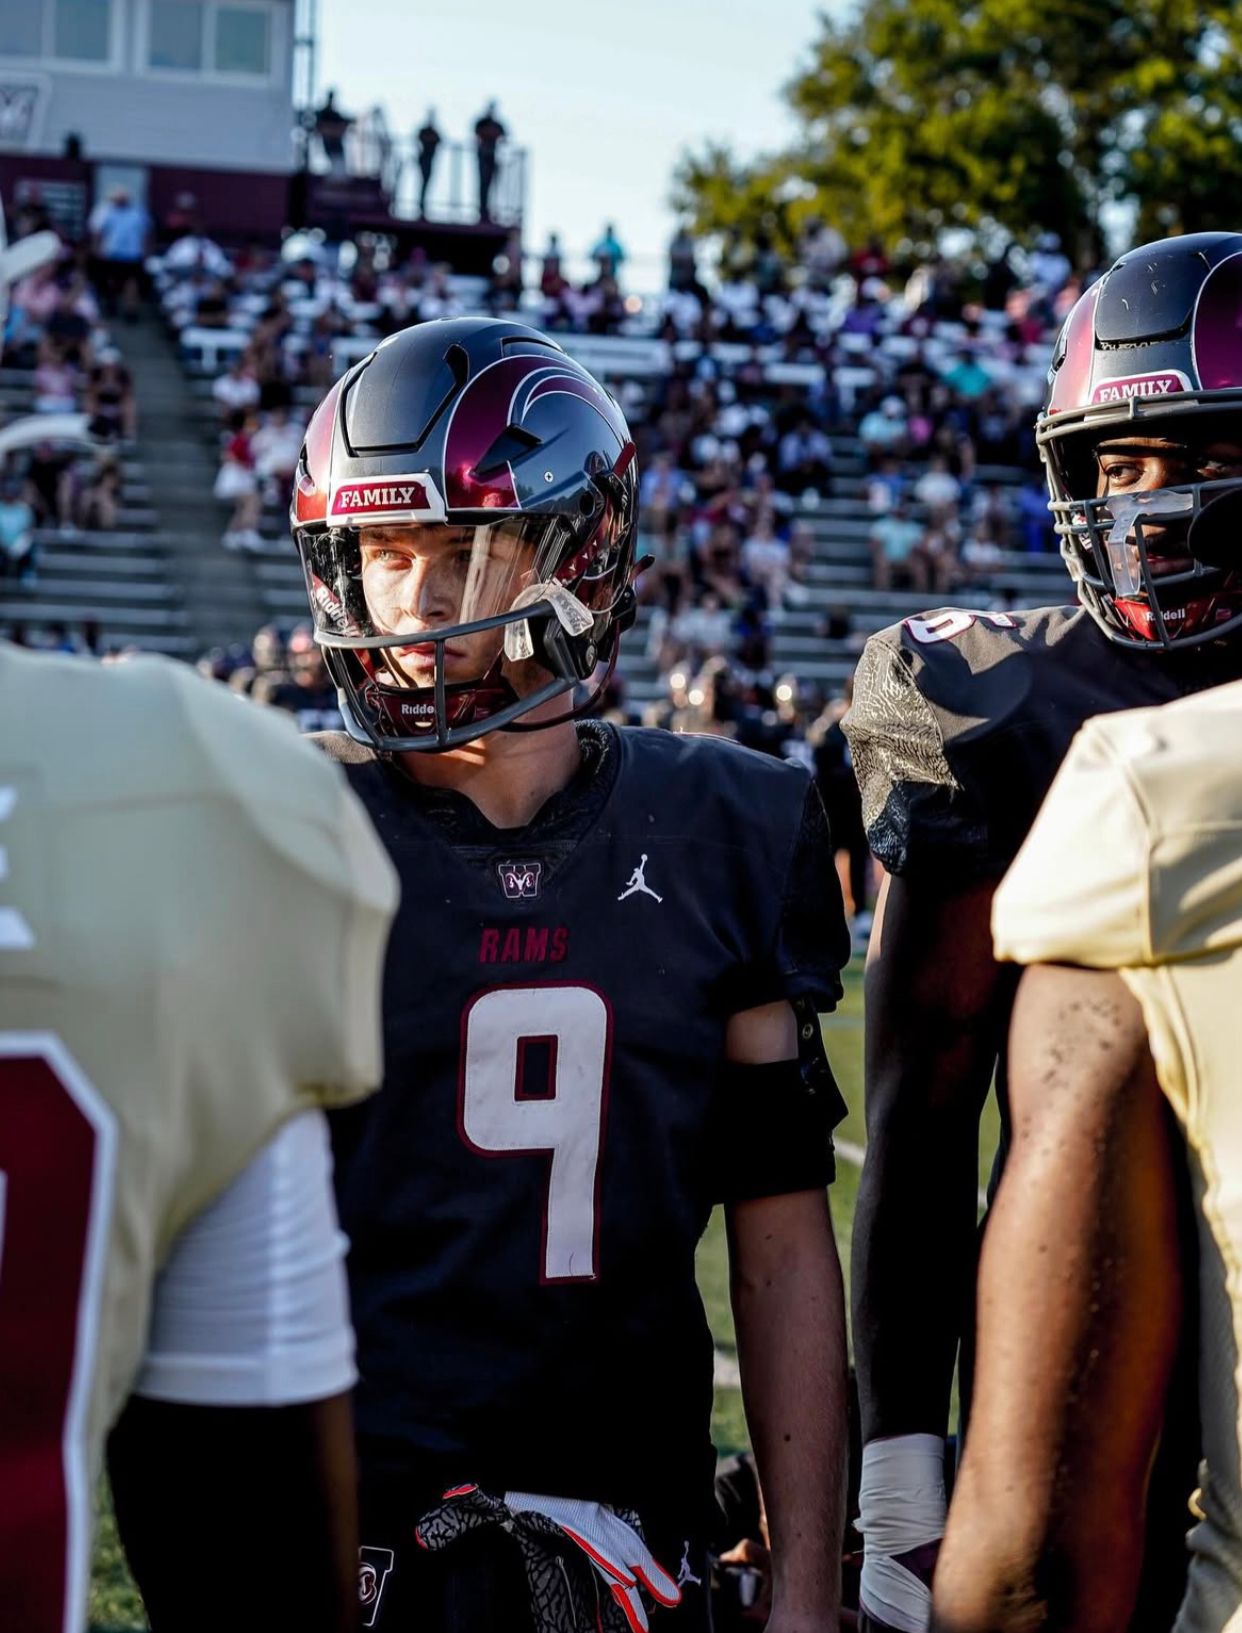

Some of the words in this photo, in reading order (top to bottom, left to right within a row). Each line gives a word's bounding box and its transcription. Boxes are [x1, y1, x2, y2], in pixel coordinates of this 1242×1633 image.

[1099, 379, 1172, 402] FAMILY
[340, 486, 415, 508] FAMILY
[1146, 608, 1185, 621] Rdell
[401, 703, 435, 715] Ridde
[479, 927, 569, 963] RAMS
[456, 980, 614, 1285] 9
